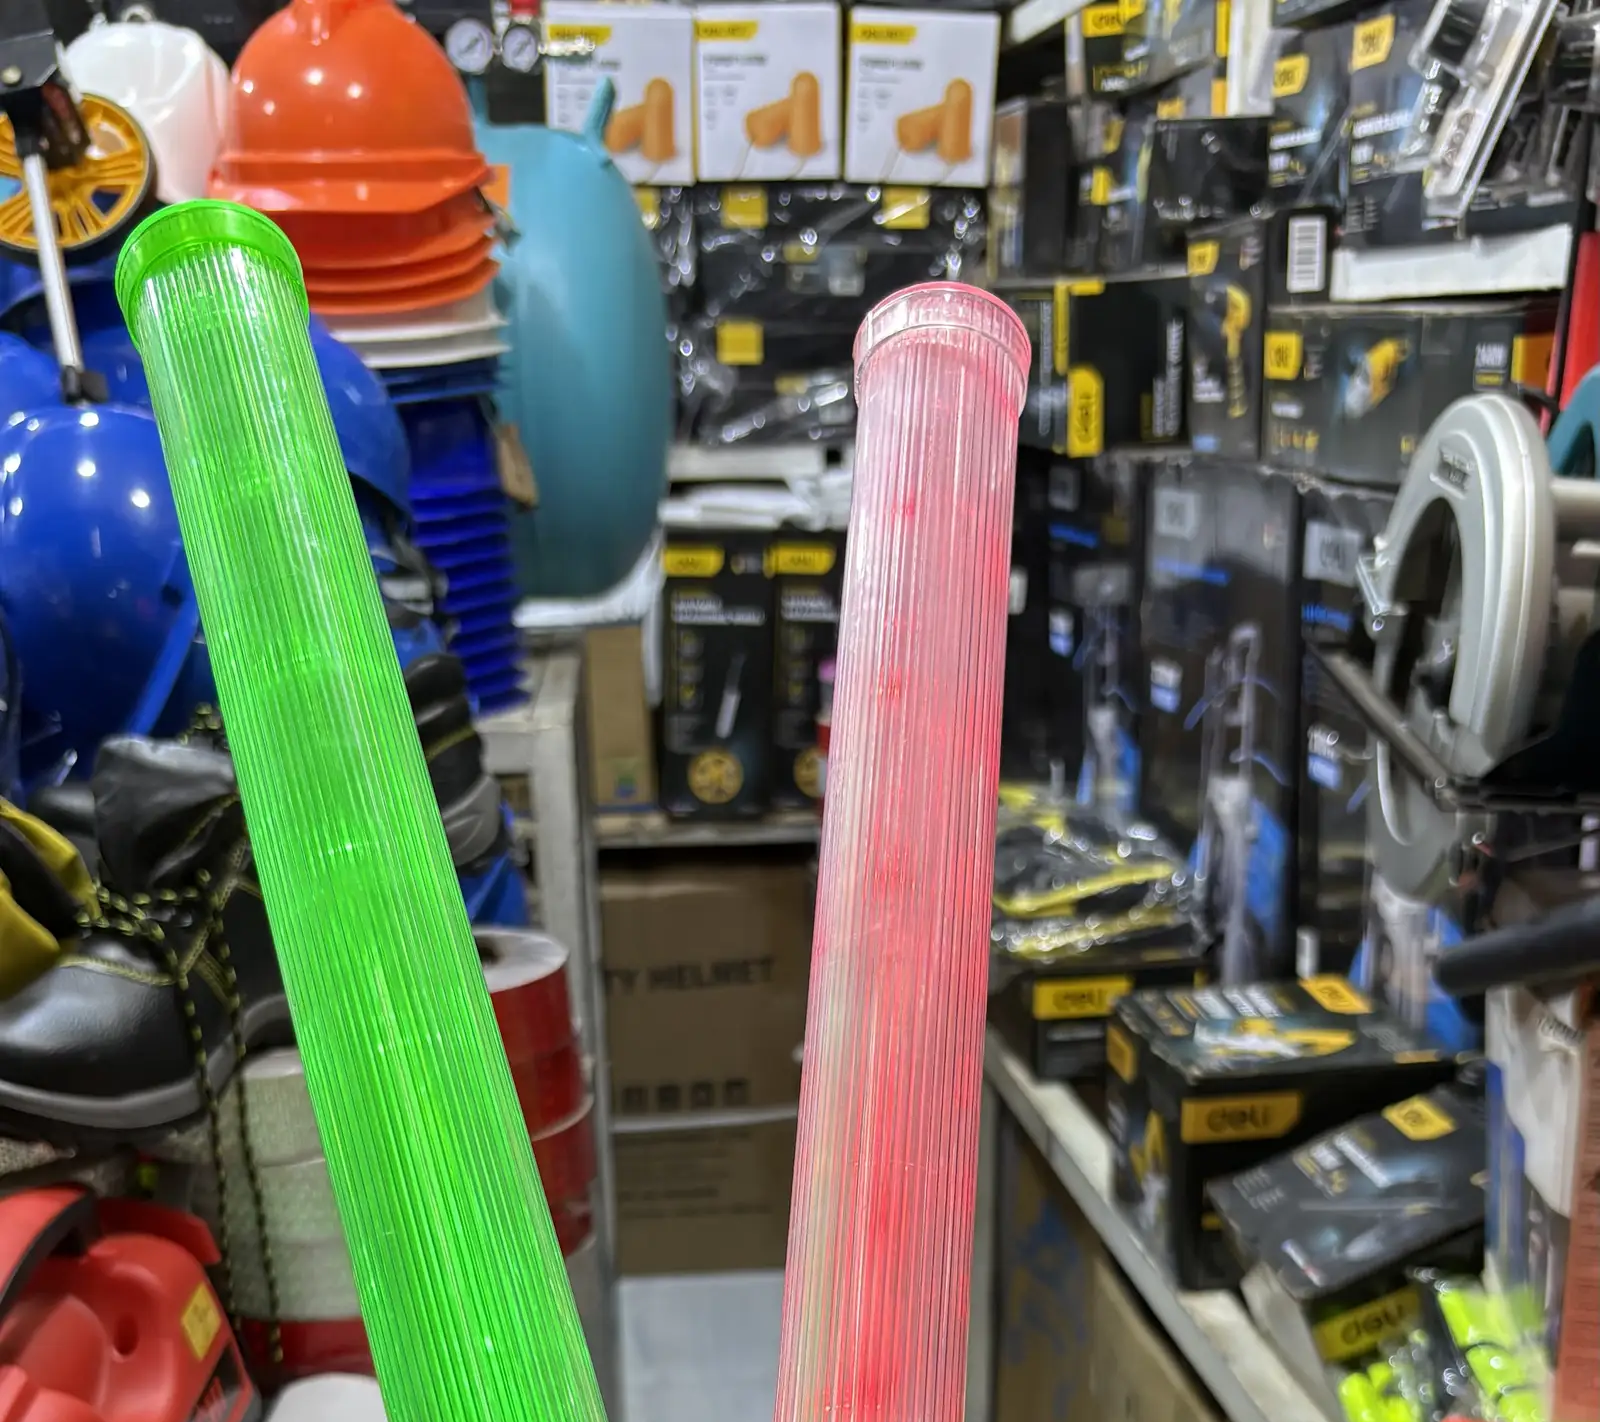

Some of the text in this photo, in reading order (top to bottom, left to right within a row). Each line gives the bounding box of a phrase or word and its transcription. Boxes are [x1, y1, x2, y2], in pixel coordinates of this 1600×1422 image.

[647, 955, 776, 992] HELMET
[1207, 1102, 1270, 1133] deli
[1340, 1302, 1404, 1346] deli
